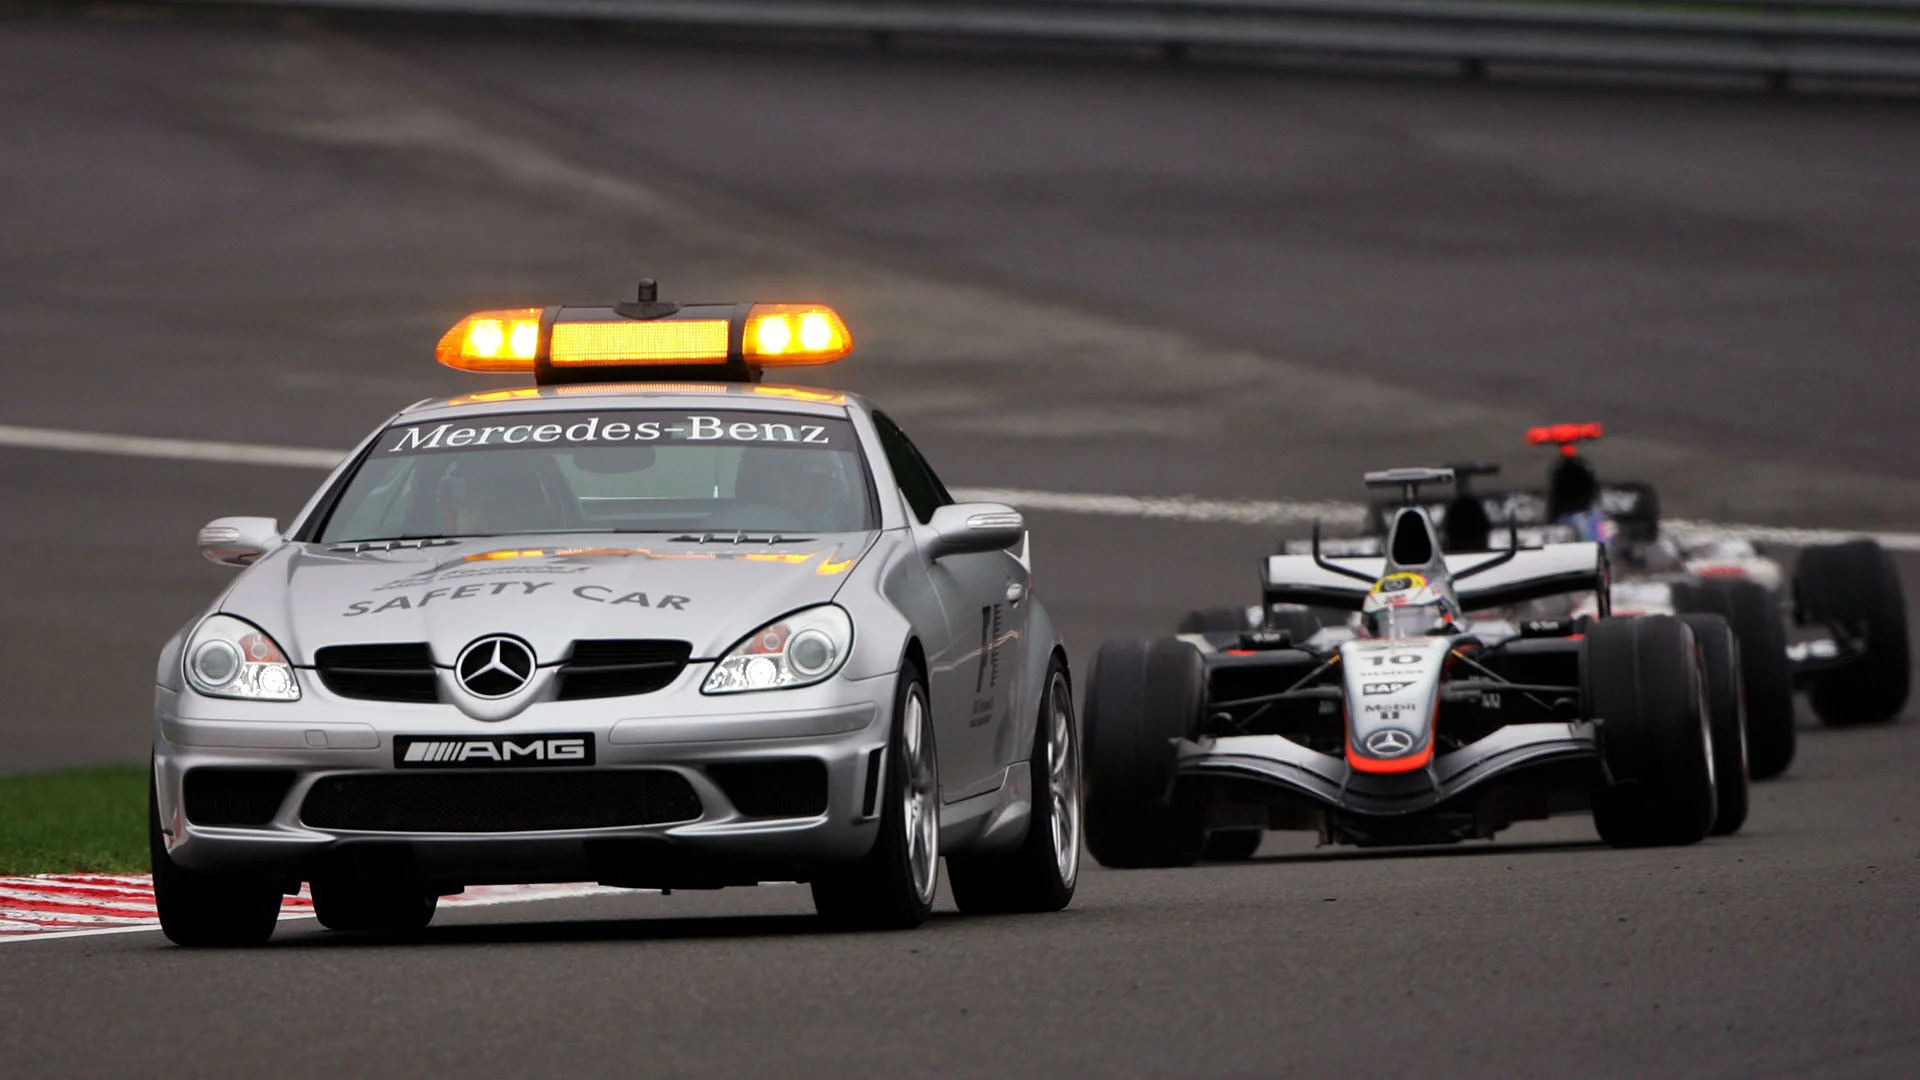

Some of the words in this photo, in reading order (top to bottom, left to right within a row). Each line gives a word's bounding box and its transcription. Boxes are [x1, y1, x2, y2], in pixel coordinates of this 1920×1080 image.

[388, 415, 830, 453] Mercedes-Benz
[343, 581, 555, 617] SAFETY
[572, 584, 692, 611] CAR
[1360, 653, 1423, 666] 10
[1363, 682, 1408, 695] SAP
[457, 738, 585, 762] AMG
